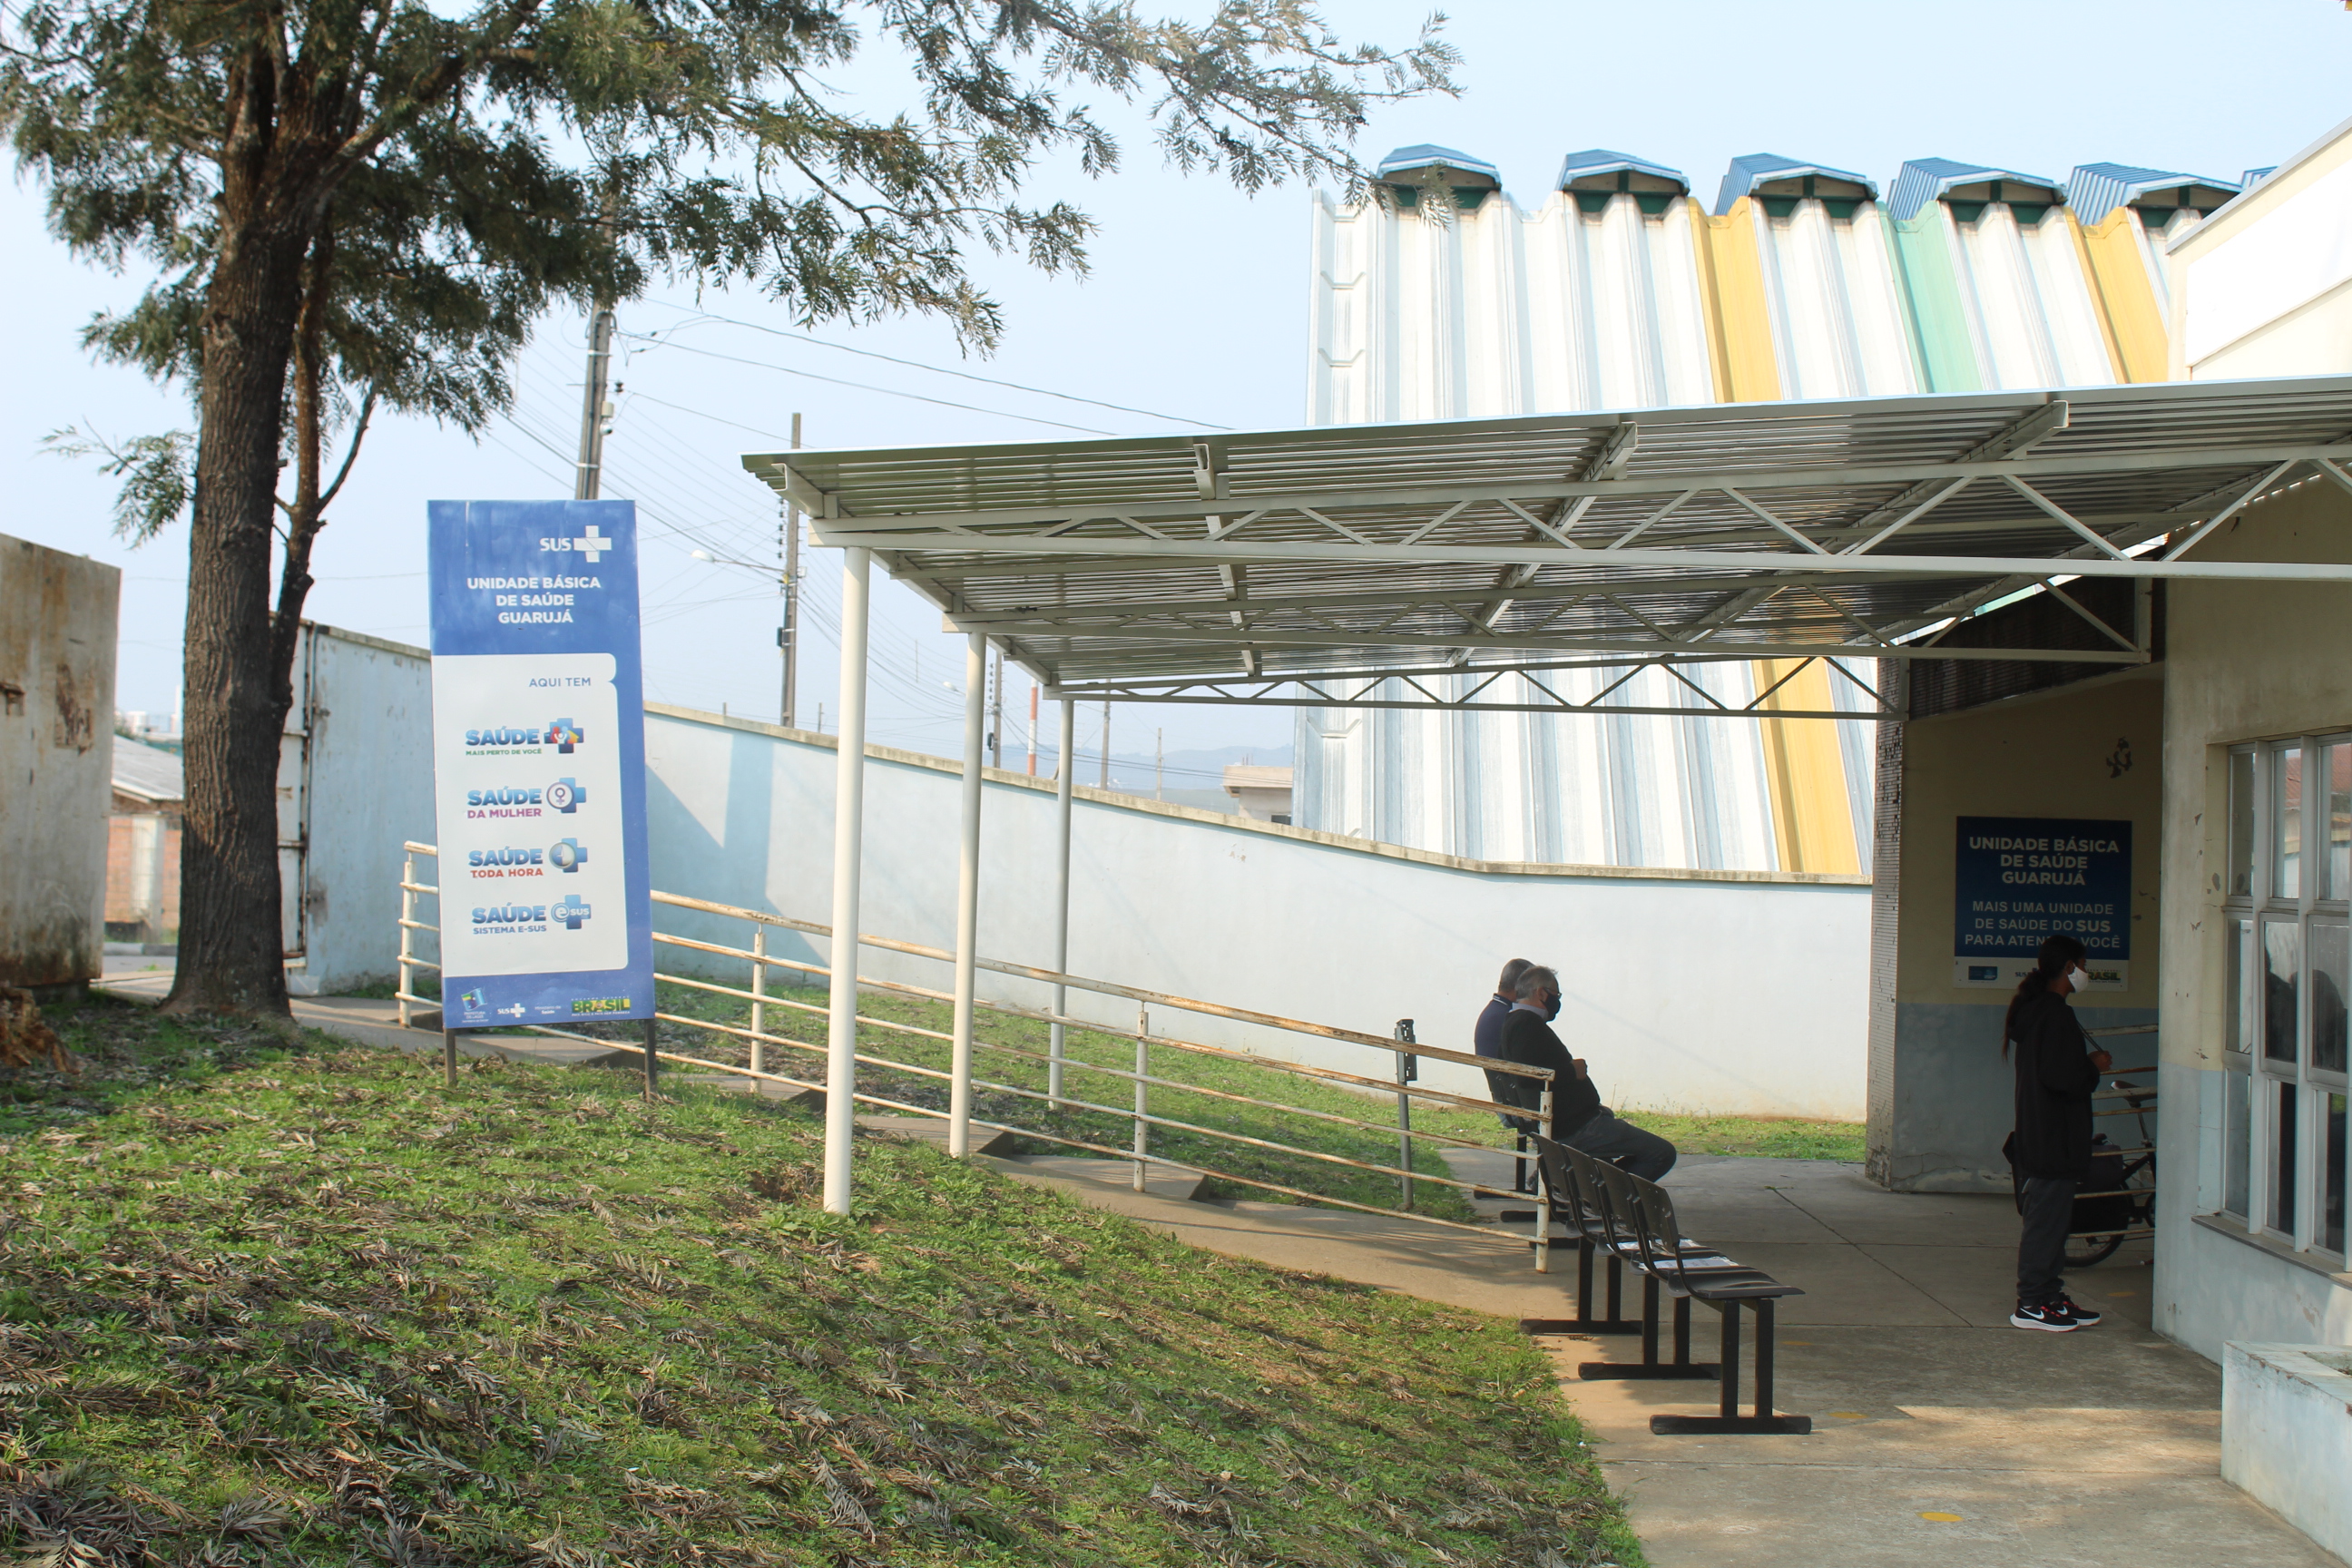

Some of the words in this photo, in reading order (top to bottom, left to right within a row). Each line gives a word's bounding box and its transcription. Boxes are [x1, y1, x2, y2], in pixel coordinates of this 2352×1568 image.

[539, 537, 572, 552] SUS
[467, 577, 538, 589] UNIDADE
[543, 574, 601, 589] BÁSICA
[495, 594, 517, 606] DE
[521, 592, 574, 606] SAÚDE
[498, 609, 573, 623] GUARUJÁ
[529, 678, 562, 688] AQUI
[565, 677, 592, 687] TEM
[466, 726, 540, 746] SAÚDE
[466, 786, 542, 806] SAÚDE
[467, 809, 485, 818] DA
[489, 808, 542, 818] MULHER
[1969, 837, 2049, 851] UNIDADE
[2053, 836, 2120, 853] BÁSICA
[468, 846, 543, 867] SAÚDE
[2000, 855, 2024, 867] DE
[2028, 853, 2088, 868] SAÚDE
[470, 868, 504, 878] TODA
[508, 867, 544, 877] HORA
[2002, 869, 2085, 886] GUARUJÁ
[471, 903, 546, 924] SAÚDE
[1973, 900, 2008, 912] MAIS
[2013, 902, 2044, 913] UMA
[2049, 903, 2113, 915] UNIDADE
[473, 926, 515, 935] SISTEMA
[517, 925, 547, 933] E-SUS
[1975, 918, 1994, 929] DE
[1998, 916, 2048, 930] SAÚDE
[2053, 919, 2073, 931] DO
[2076, 919, 2111, 933] SUS
[1965, 934, 2004, 946] PARA
[2082, 936, 2121, 948] VOCÊ
[2087, 971, 2121, 980] RASIL
[572, 999, 631, 1013] BRASIL
